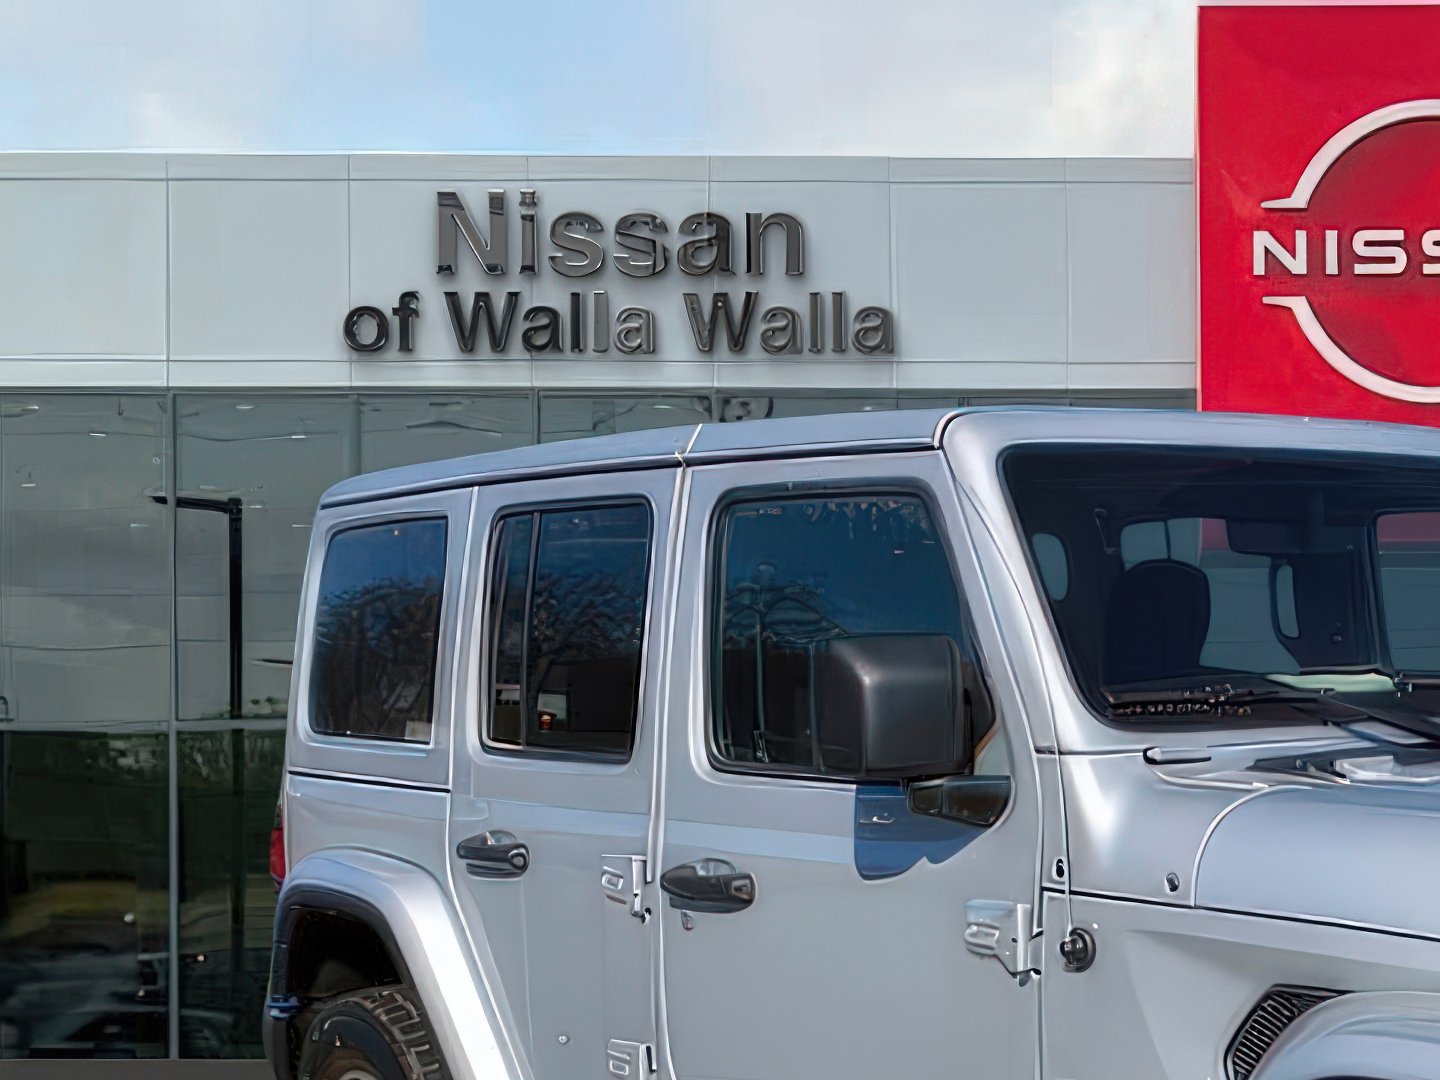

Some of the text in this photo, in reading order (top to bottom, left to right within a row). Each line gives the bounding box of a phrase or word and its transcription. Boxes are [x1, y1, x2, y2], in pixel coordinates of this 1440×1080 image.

[435, 188, 805, 278] Nissan
[341, 290, 896, 355] of Walla Walla
